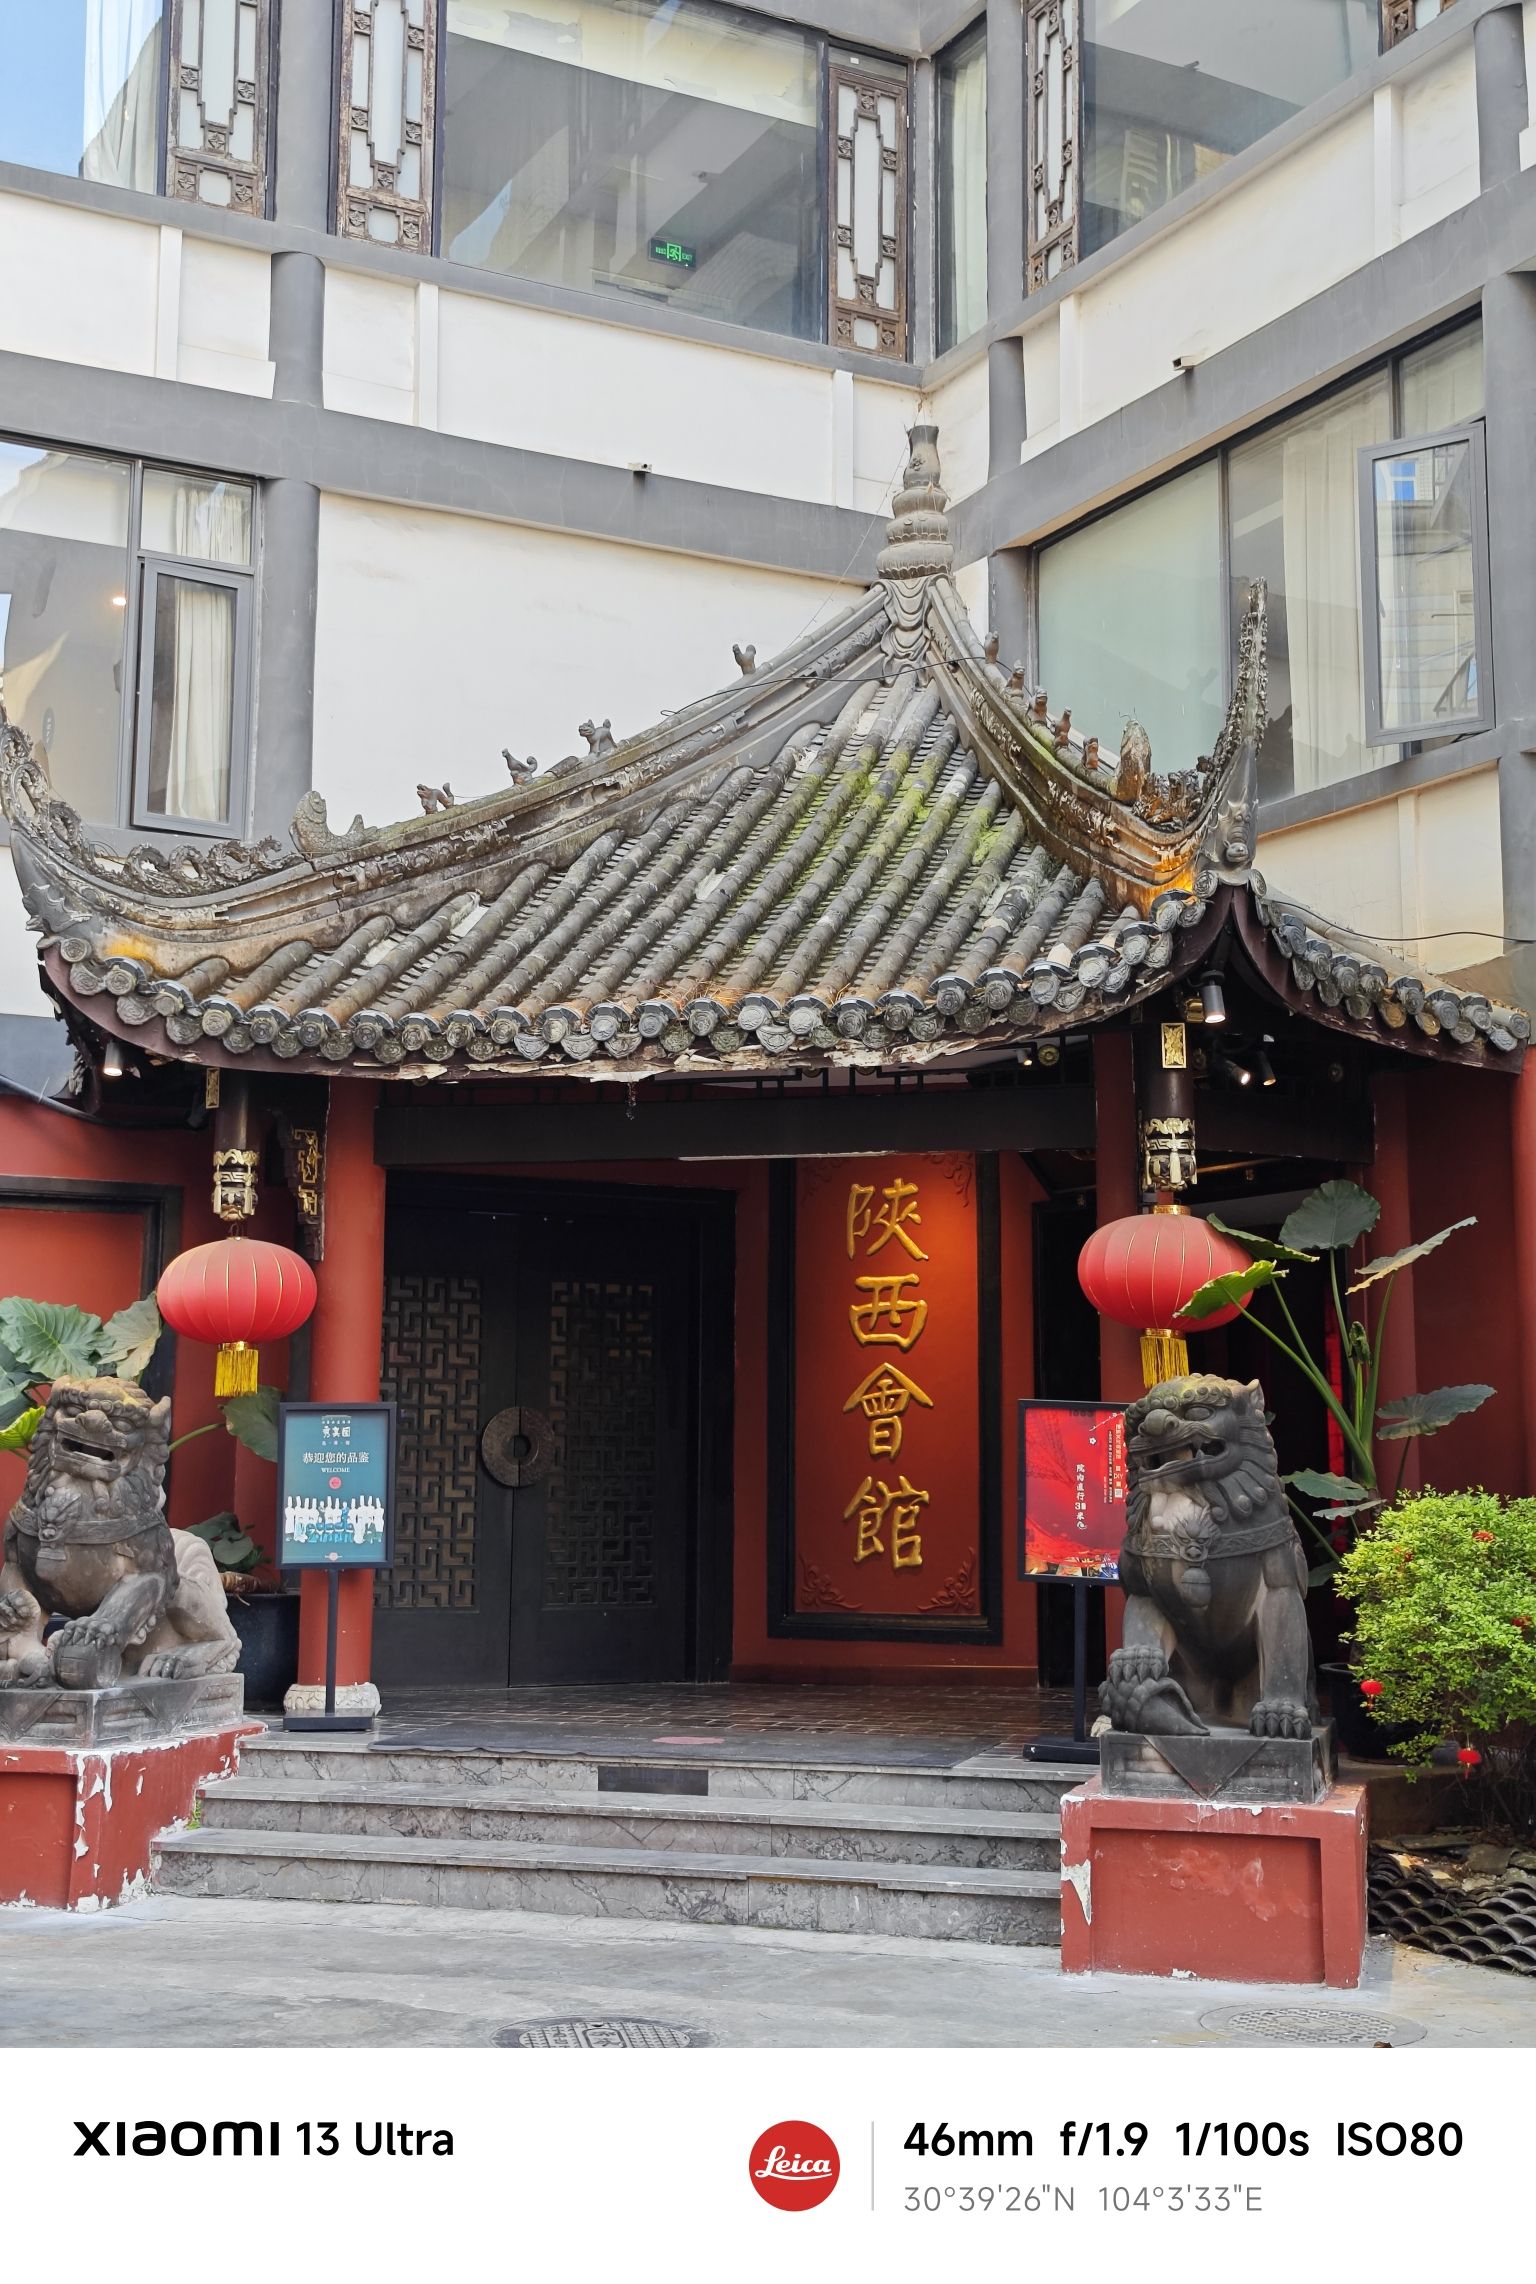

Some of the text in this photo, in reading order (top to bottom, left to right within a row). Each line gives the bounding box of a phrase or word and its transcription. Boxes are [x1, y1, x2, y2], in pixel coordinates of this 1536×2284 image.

[303, 1451, 369, 1464] 恭迎您的品鉴
[843, 1178, 934, 1569] 陝西會館
